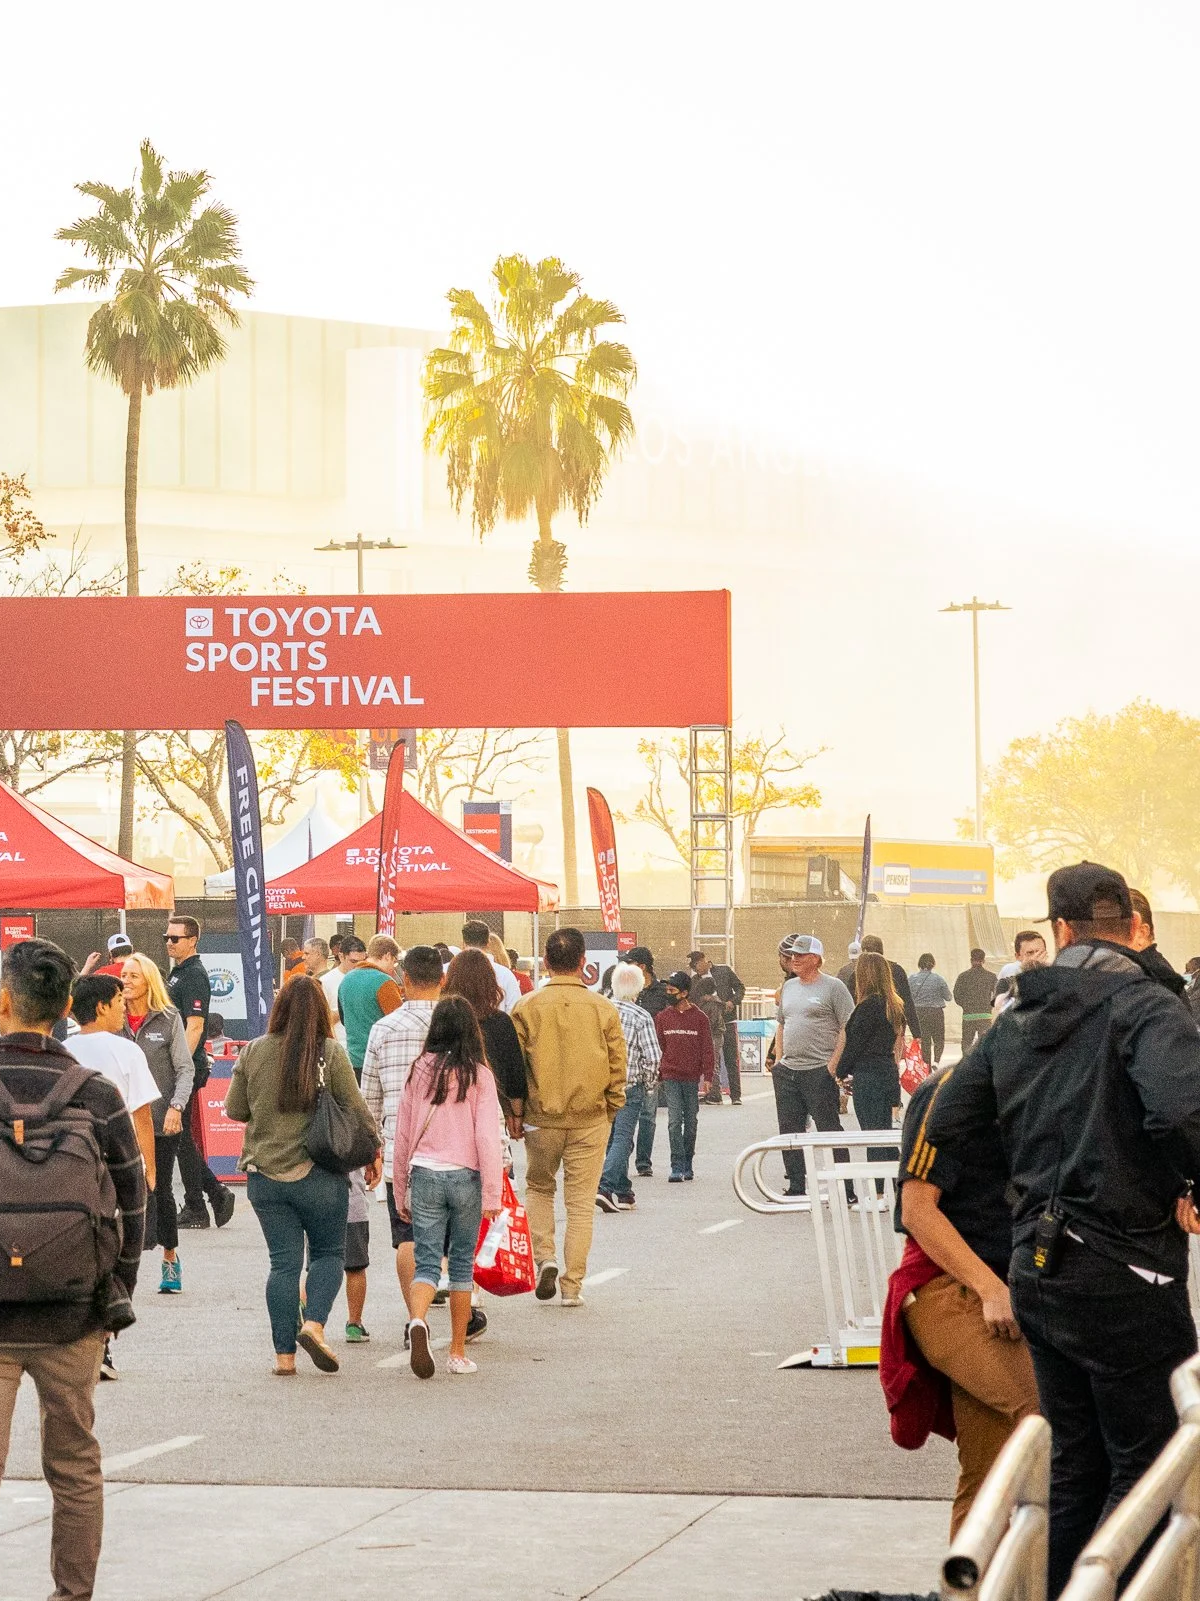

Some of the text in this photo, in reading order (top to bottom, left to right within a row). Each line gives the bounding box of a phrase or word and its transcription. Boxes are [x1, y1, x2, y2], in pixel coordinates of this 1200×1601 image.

[224, 606, 382, 637] TOYOTA
[185, 641, 328, 672] SPORTS
[251, 675, 425, 706] FESTIVAL
[236, 765, 255, 859] FREE
[345, 855, 410, 865] SPOS
[373, 862, 451, 873] FSTIVAL
[885, 874, 909, 886] PENSKE
[269, 901, 306, 909] FESTIVAL
